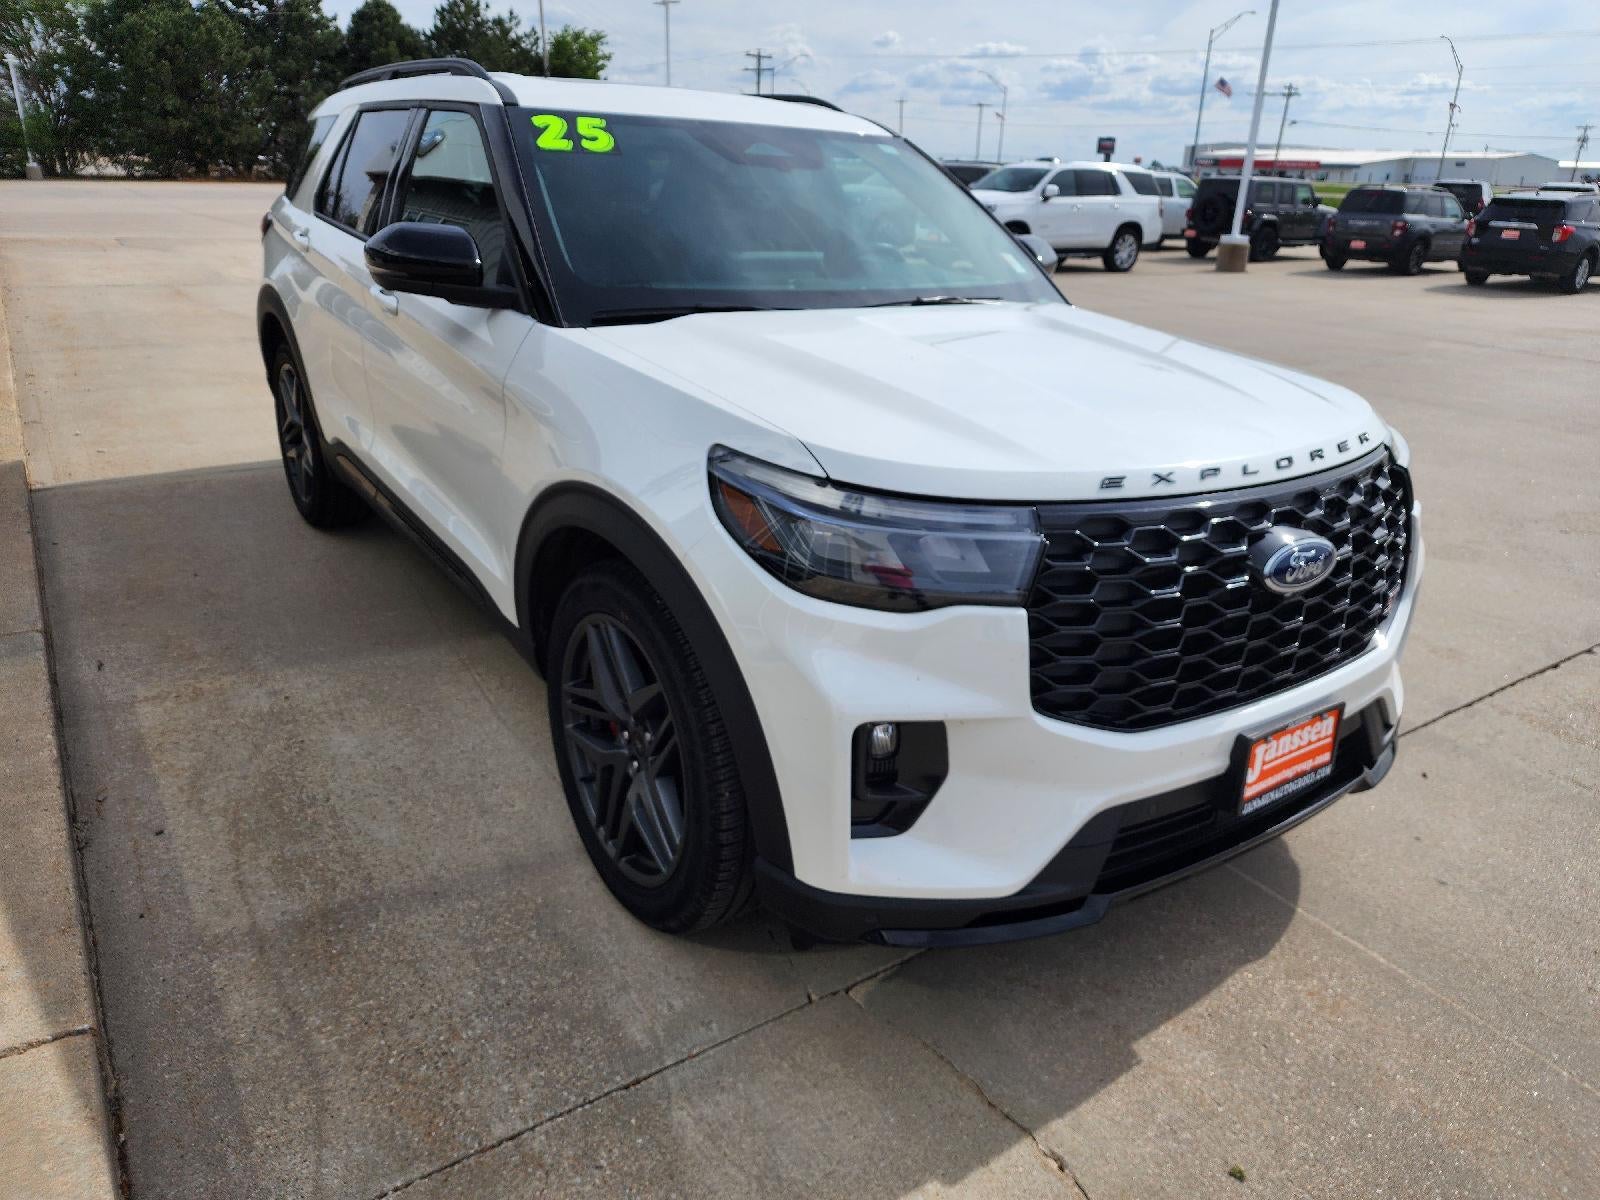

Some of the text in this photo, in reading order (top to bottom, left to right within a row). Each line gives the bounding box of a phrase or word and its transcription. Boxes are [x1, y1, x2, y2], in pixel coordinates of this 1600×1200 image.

[531, 114, 615, 153] 25
[1099, 431, 1371, 489] EXPLORER
[1284, 549, 1326, 583] Ford
[1246, 715, 1335, 784] Janssen
